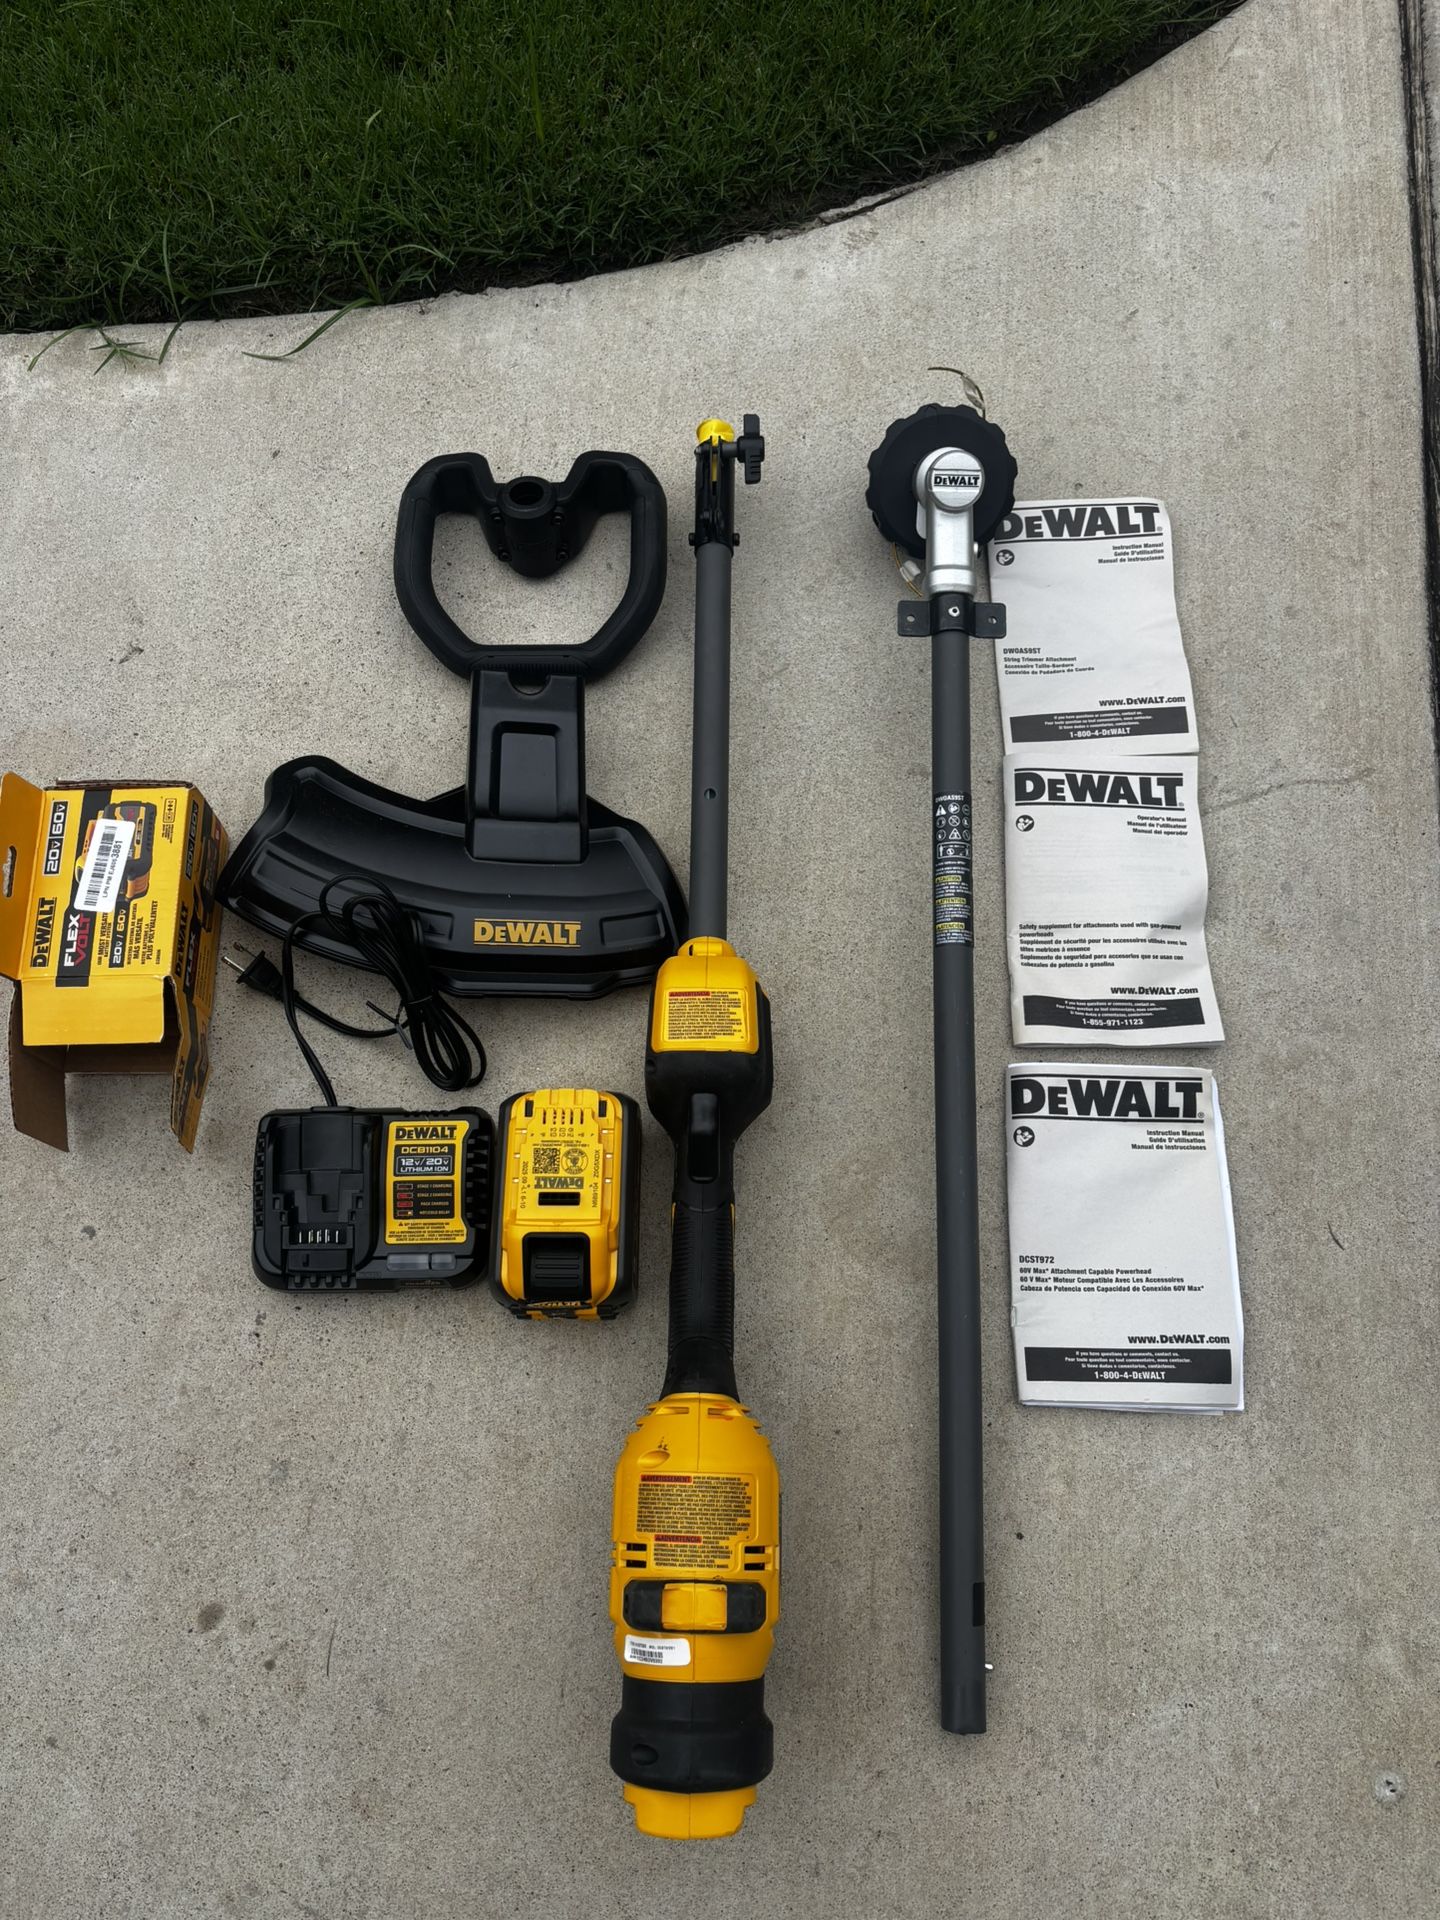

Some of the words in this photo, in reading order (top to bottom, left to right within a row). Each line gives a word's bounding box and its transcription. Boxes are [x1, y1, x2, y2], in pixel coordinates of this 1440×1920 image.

[933, 475, 980, 486] DEWALT
[994, 506, 1160, 540] DEWALT
[1112, 543, 1142, 551] Instruction
[1099, 696, 1186, 707] www.DEWALT.com
[1069, 727, 1131, 738] 1-800-4-DEWALT
[1014, 772, 1183, 807] DEWALT
[102, 886, 110, 898] LPN
[106, 876, 112, 885] PM
[32, 897, 56, 967] DEWALT
[473, 921, 582, 945] DEWALT
[64, 913, 80, 967] FLEX
[75, 913, 91, 965] VOLT
[1110, 986, 1198, 995] www.DEWALT.com
[1011, 1079, 1204, 1118] DEWALT
[395, 1126, 457, 1139] DEWALT
[1168, 1136, 1205, 1144] D'utilisation
[401, 1146, 448, 1154] DCB1104
[534, 1177, 584, 1189] DEWALT
[1019, 1255, 1054, 1263] DCST972
[1088, 1268, 1115, 1276] Capable
[1077, 1276, 1113, 1284] Compatible
[1096, 1285, 1131, 1293] Capacidad
[1128, 1334, 1230, 1344] www.DEWALT.com
[1094, 1371, 1166, 1380] 1-800-4-DEWALT
